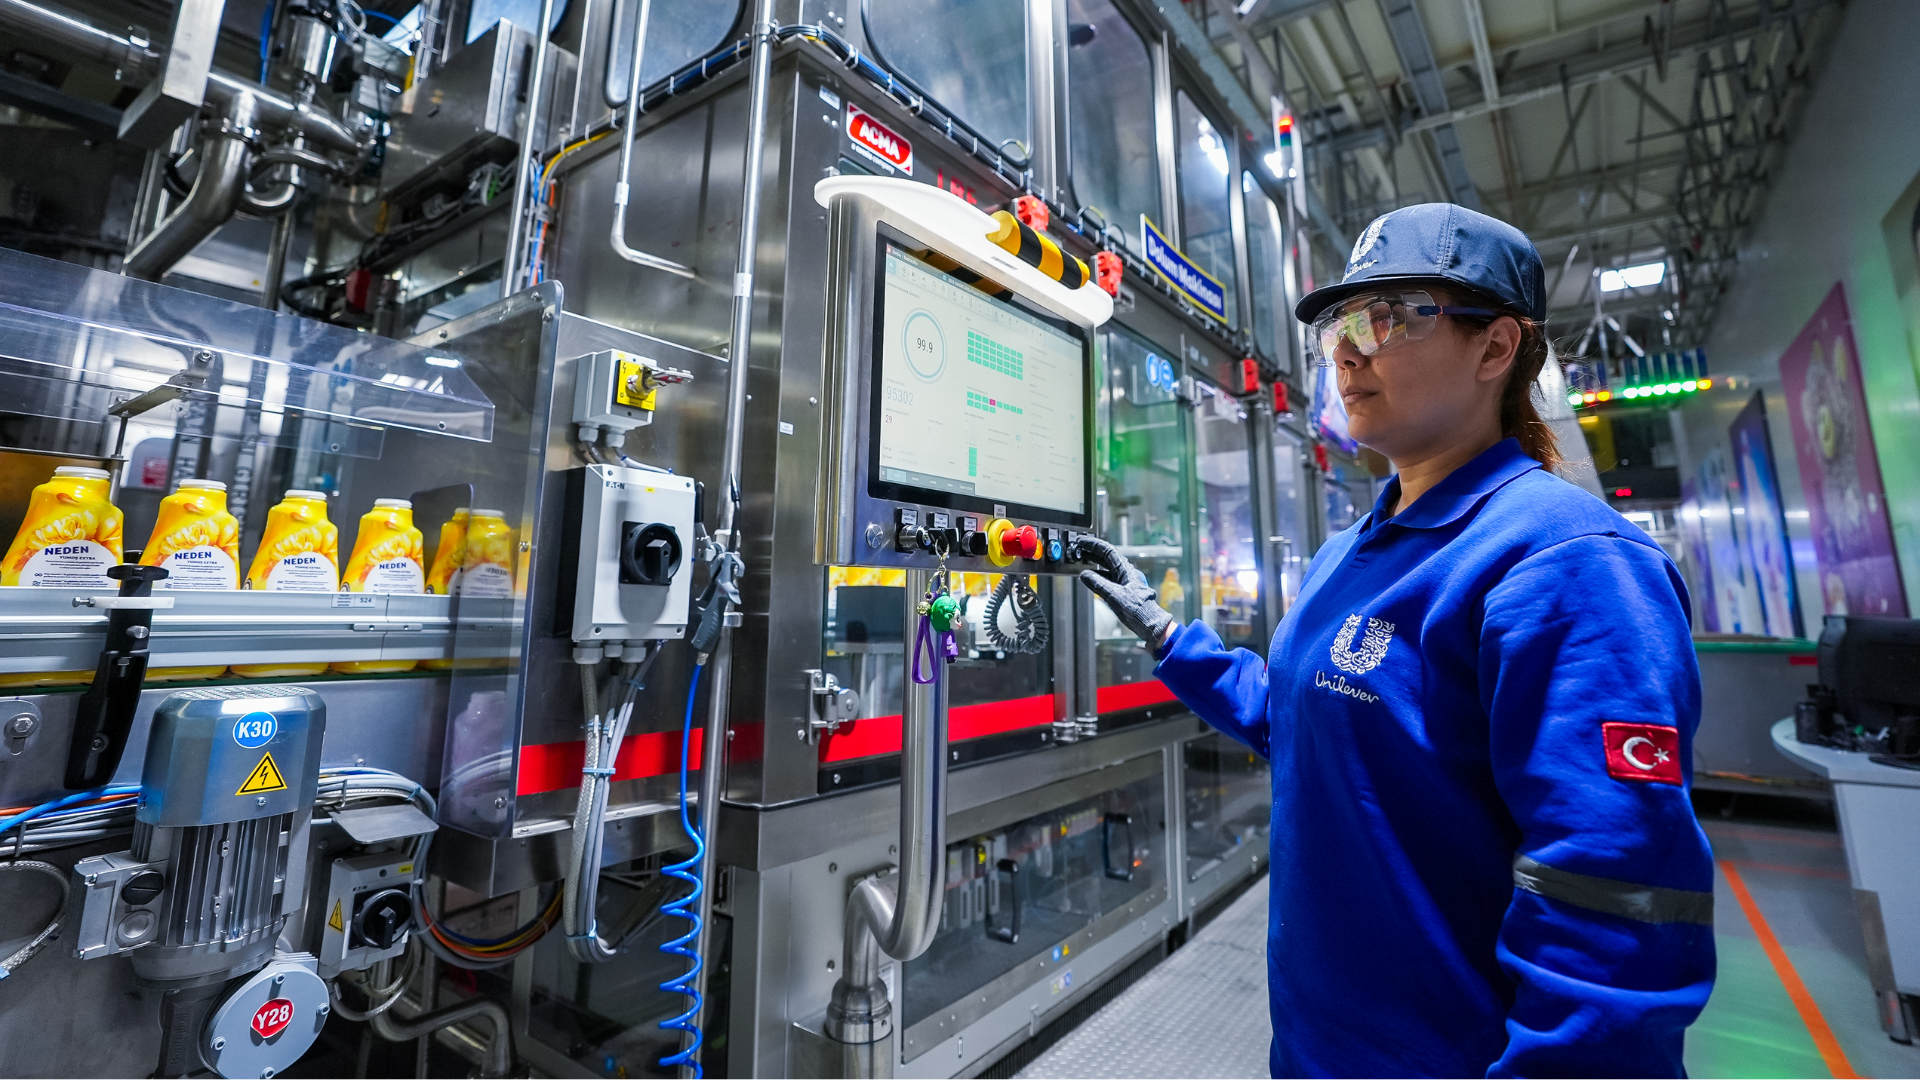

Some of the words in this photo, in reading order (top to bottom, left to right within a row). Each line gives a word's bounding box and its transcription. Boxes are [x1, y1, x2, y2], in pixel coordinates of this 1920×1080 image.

[859, 121, 901, 160] ACMA
[1147, 234, 1179, 280] Dolum
[916, 337, 934, 354] 99.9
[886, 385, 914, 407] 95302
[885, 414, 893, 424] 29
[44, 545, 90, 556] NEDEN
[174, 551, 212, 560] NEDEN
[283, 557, 316, 565] NEDEN
[379, 562, 407, 570] NEDEN
[1315, 670, 1380, 704] Unilever
[238, 720, 273, 739] K30
[256, 1004, 290, 1030] Y28
